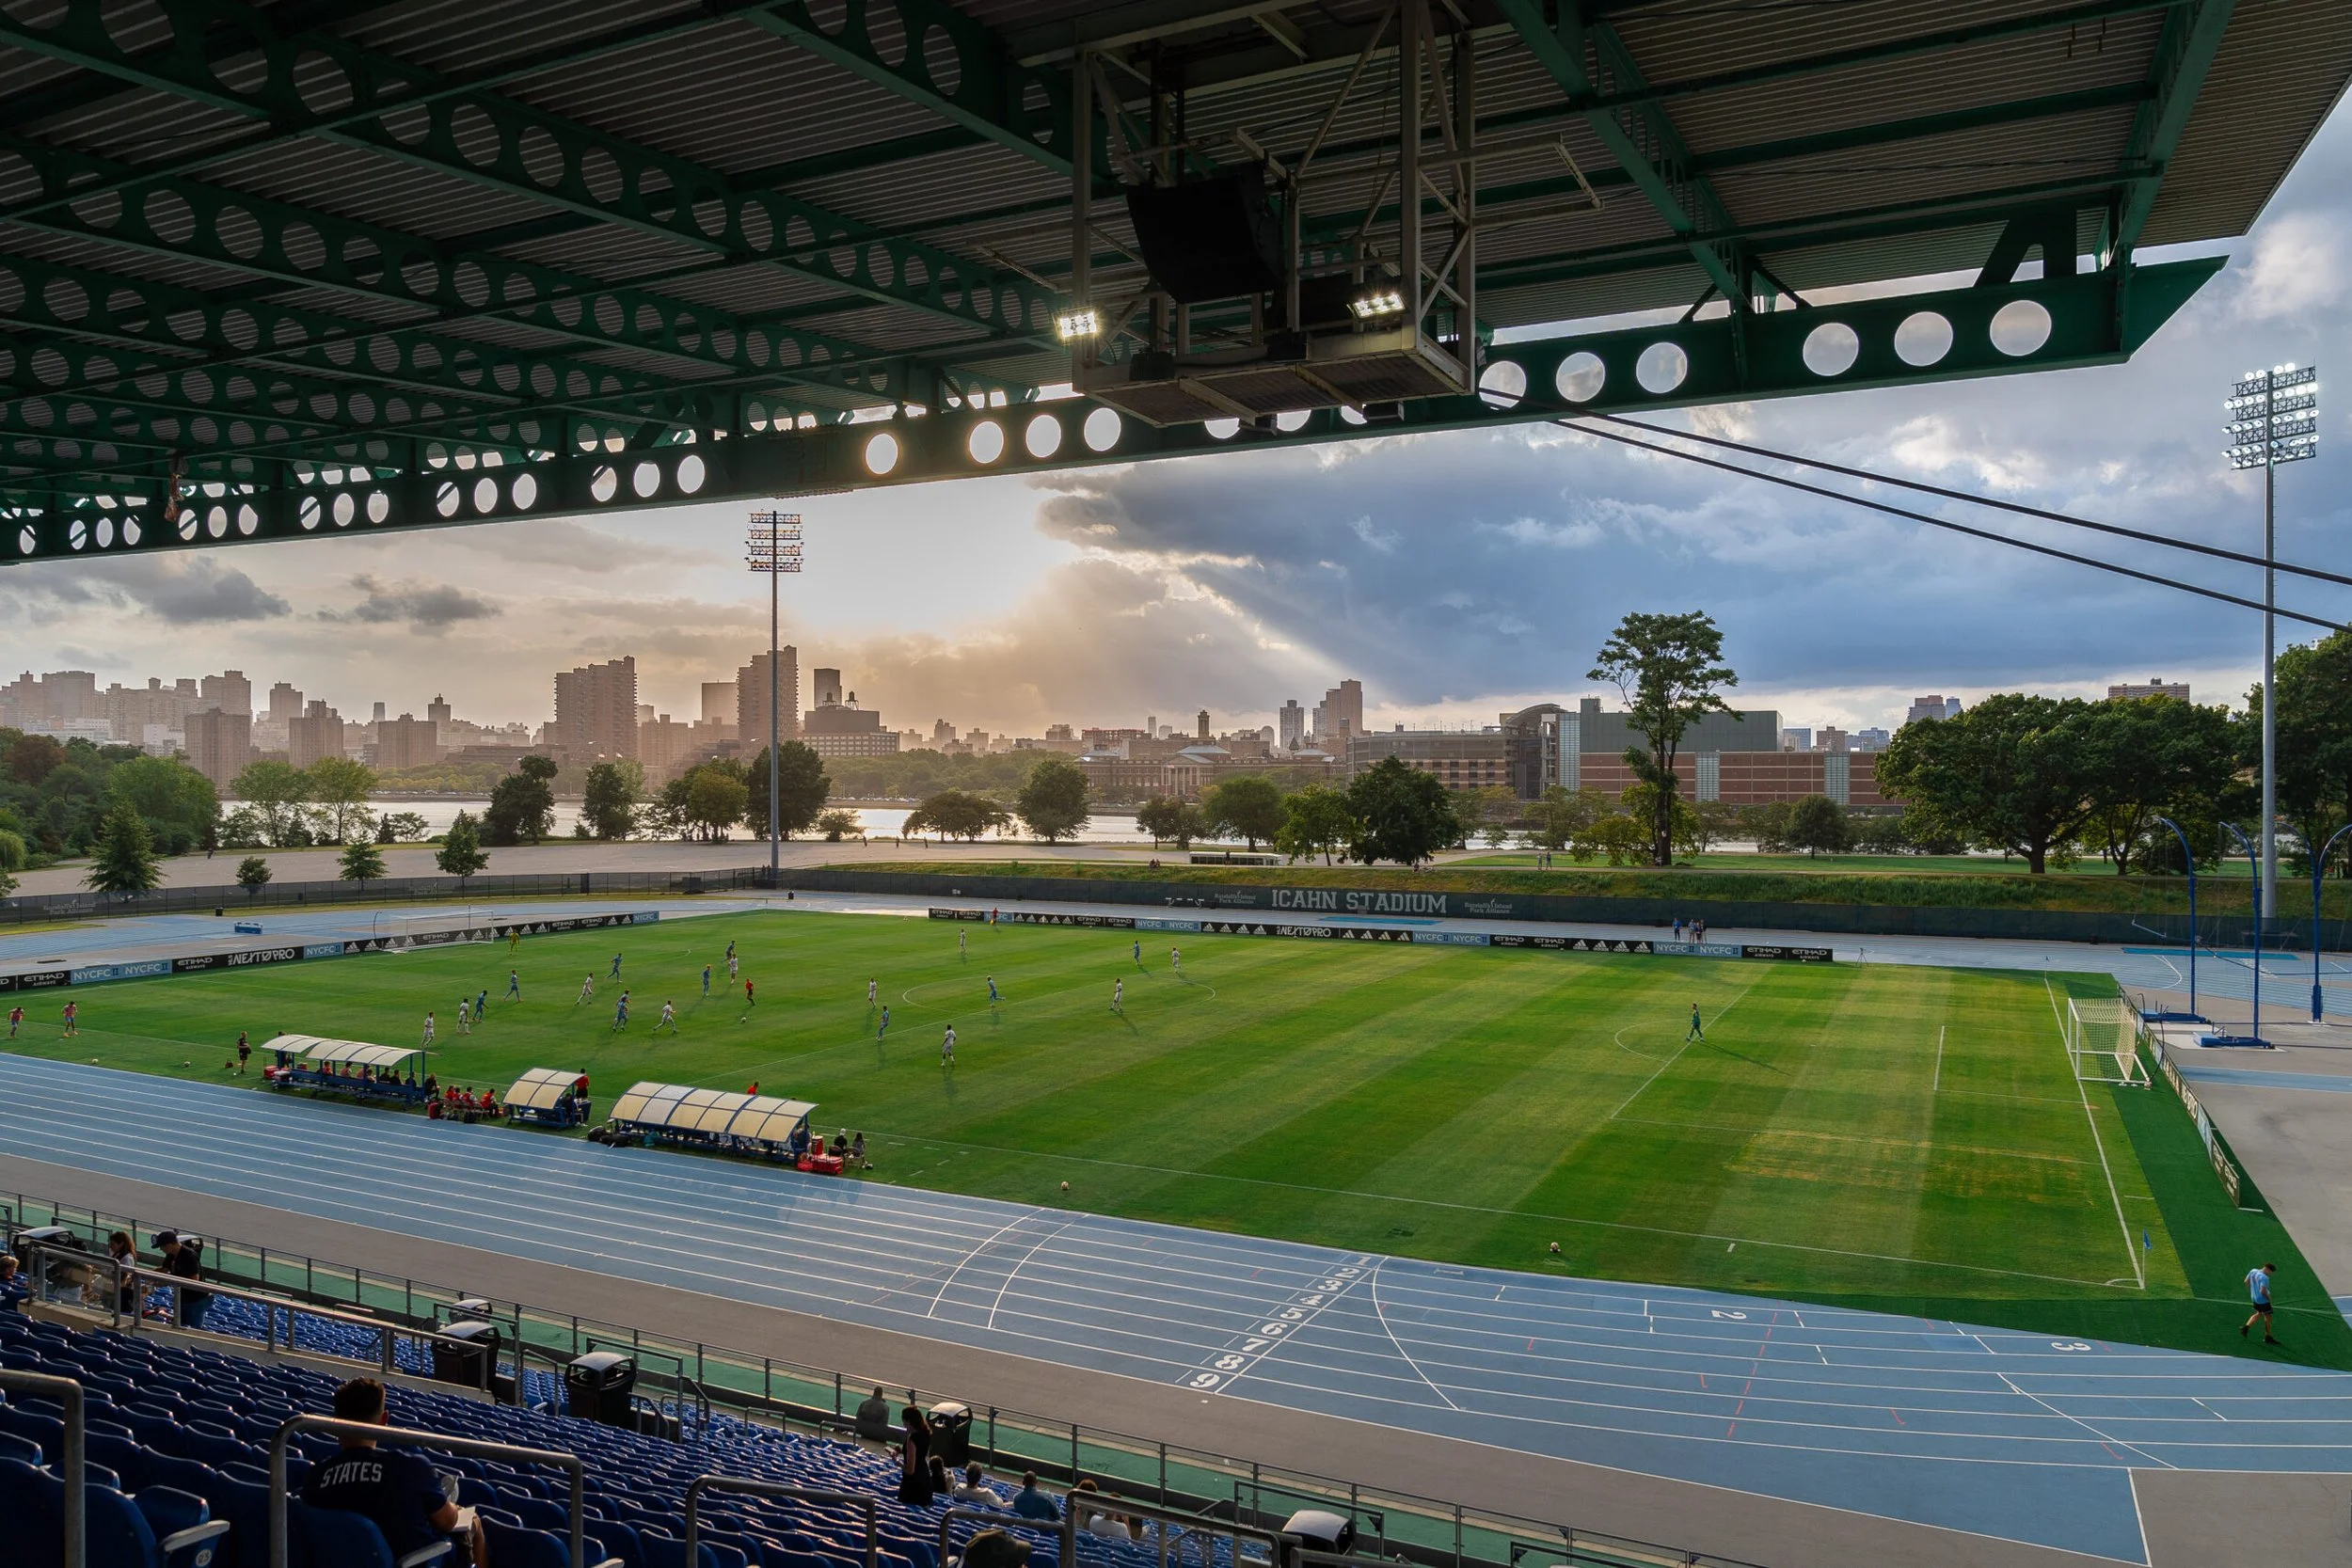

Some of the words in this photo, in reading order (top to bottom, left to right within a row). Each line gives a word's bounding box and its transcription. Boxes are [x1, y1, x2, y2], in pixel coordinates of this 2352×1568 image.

[1272, 890, 1338, 910] ICAHN
[1346, 892, 1447, 913] STADIUM
[1415, 933, 1442, 942] NYCFC
[307, 945, 335, 956] NYCFC
[1656, 943, 1687, 953] NYCFC
[1700, 945, 1731, 954] NYCFC
[178, 958, 213, 966] ETIHAD
[124, 963, 161, 975] NYCFC
[24, 973, 65, 982] ETIHAD
[74, 969, 111, 981] NYCFC
[1352, 1257, 1373, 1266] 1
[1335, 1268, 1360, 1279] 2
[1317, 1280, 1343, 1291] 3
[1299, 1294, 1324, 1306] 4
[1279, 1307, 1309, 1319] 5
[1710, 1309, 1746, 1320] 2
[1261, 1323, 1288, 1336] 6
[1242, 1338, 1270, 1352] 7
[2051, 1342, 2091, 1352] 3
[1215, 1354, 1245, 1370] 8
[1189, 1373, 1220, 1388] 9
[320, 1462, 383, 1488] STATES
